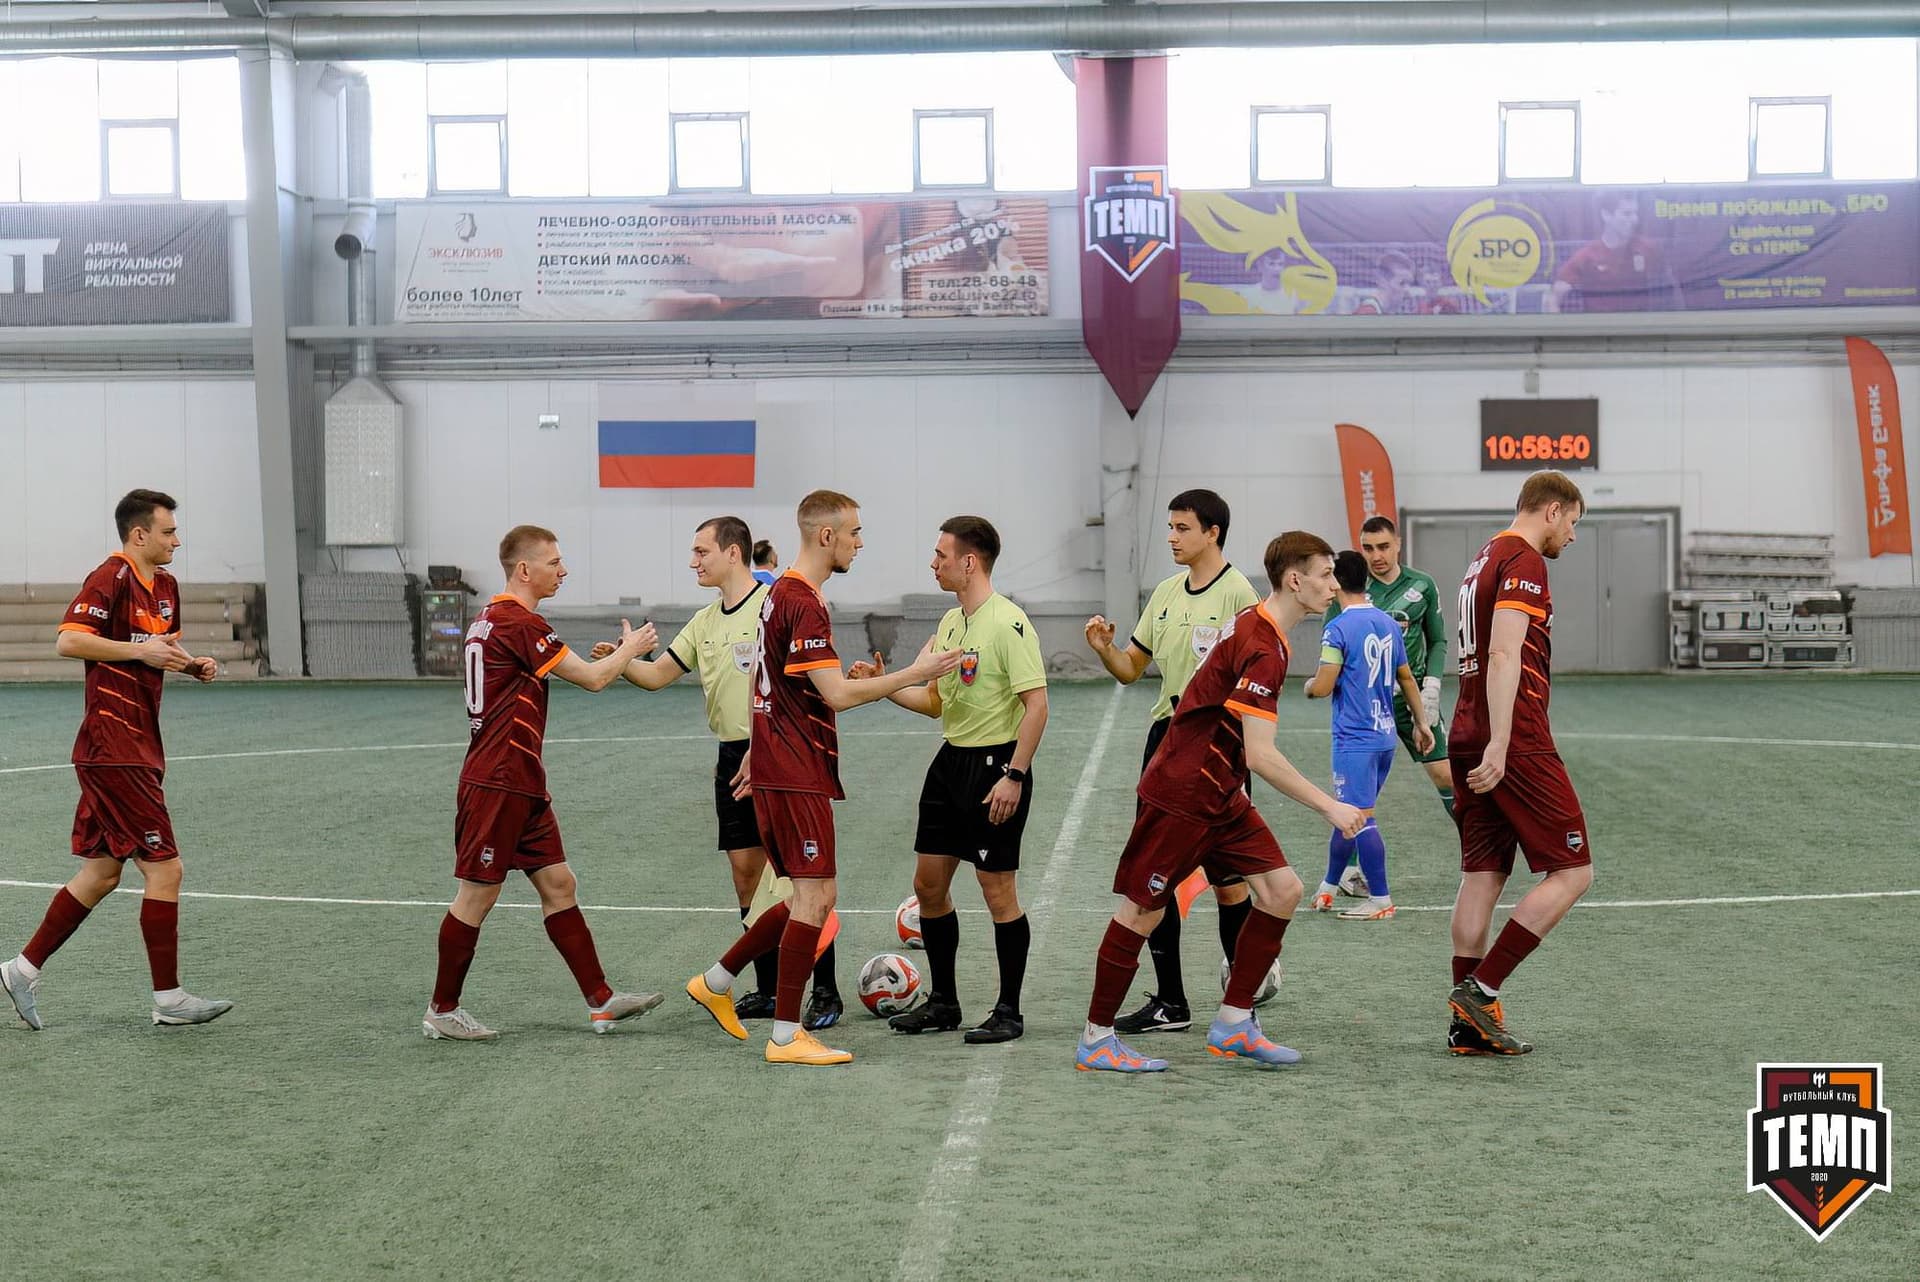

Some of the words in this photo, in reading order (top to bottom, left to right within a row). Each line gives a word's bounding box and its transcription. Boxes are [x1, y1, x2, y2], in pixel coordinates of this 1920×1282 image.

[782, 213, 857, 225] МАССАЖ:
[1094, 199, 1166, 238] ТЕМП
[84, 241, 129, 254] АРЕНА
[1473, 239, 1531, 258] .БРО
[85, 254, 183, 271] ВИРТУАЛЬНОЙ
[538, 252, 611, 267] ДЕТСКИЙ
[616, 255, 690, 266] МАССАЖ:
[85, 273, 176, 287] РЕАЛЬНОСТИ
[407, 287, 463, 302] более
[470, 288, 523, 302] 10лет
[1519, 579, 1542, 595] ПСБ
[89, 606, 109, 619] ПСБ
[804, 638, 827, 649] ПСБ
[1363, 632, 1393, 689] 91
